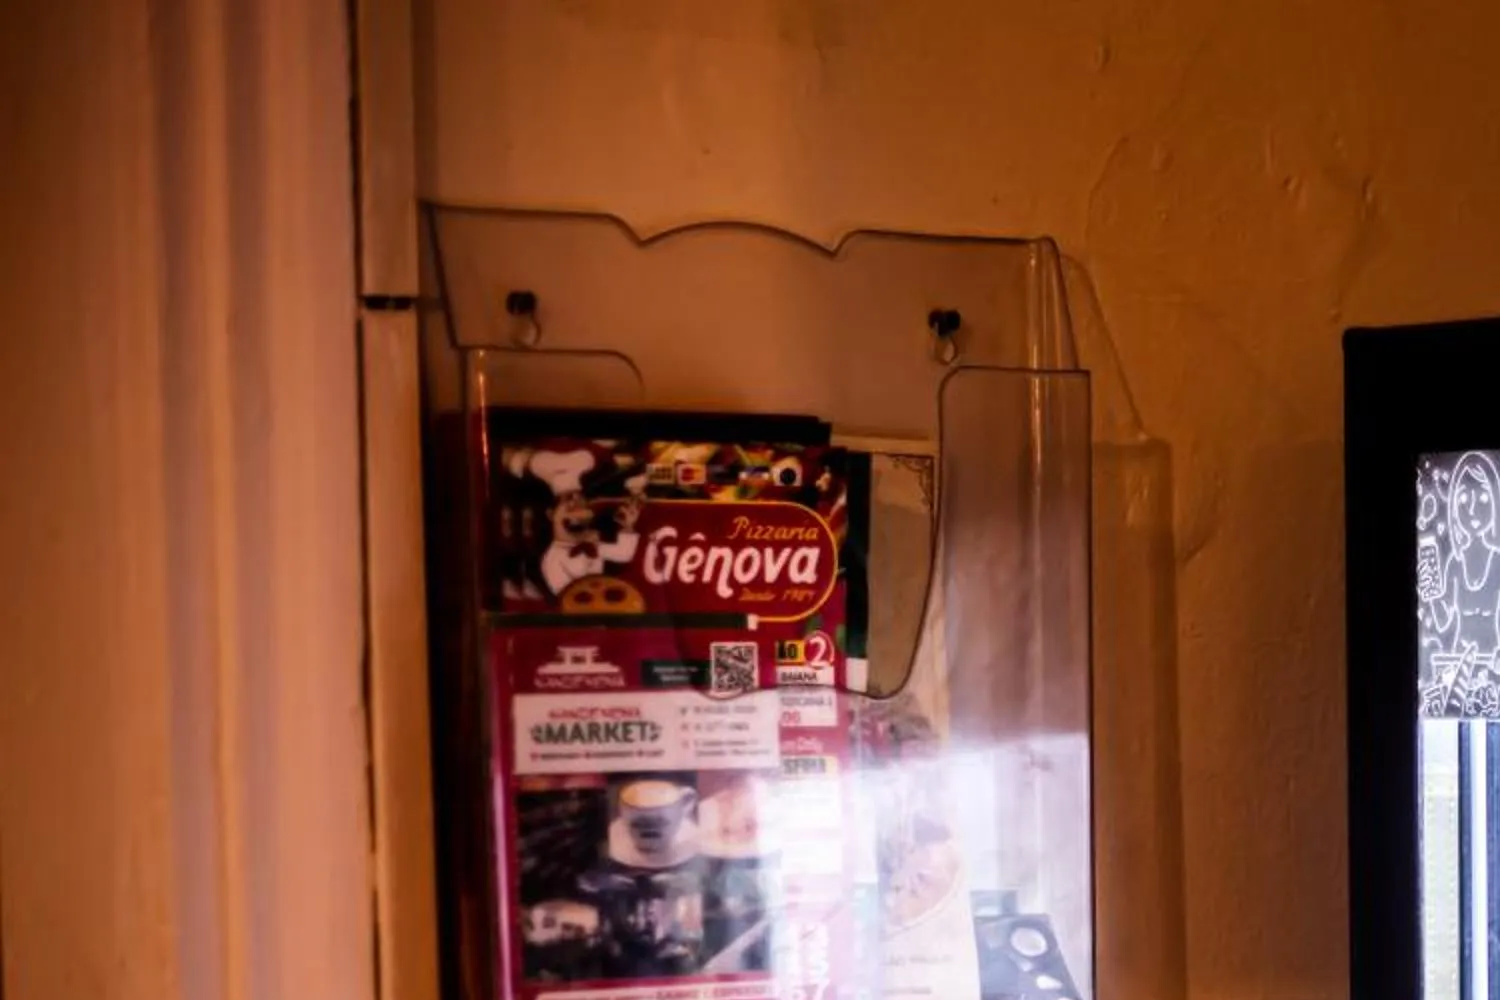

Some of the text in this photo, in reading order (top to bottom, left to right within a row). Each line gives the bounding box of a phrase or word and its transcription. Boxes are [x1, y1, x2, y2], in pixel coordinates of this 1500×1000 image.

[727, 515, 819, 541] Pizzaria
[643, 526, 821, 599] Gênova
[546, 721, 648, 745] MARKET
